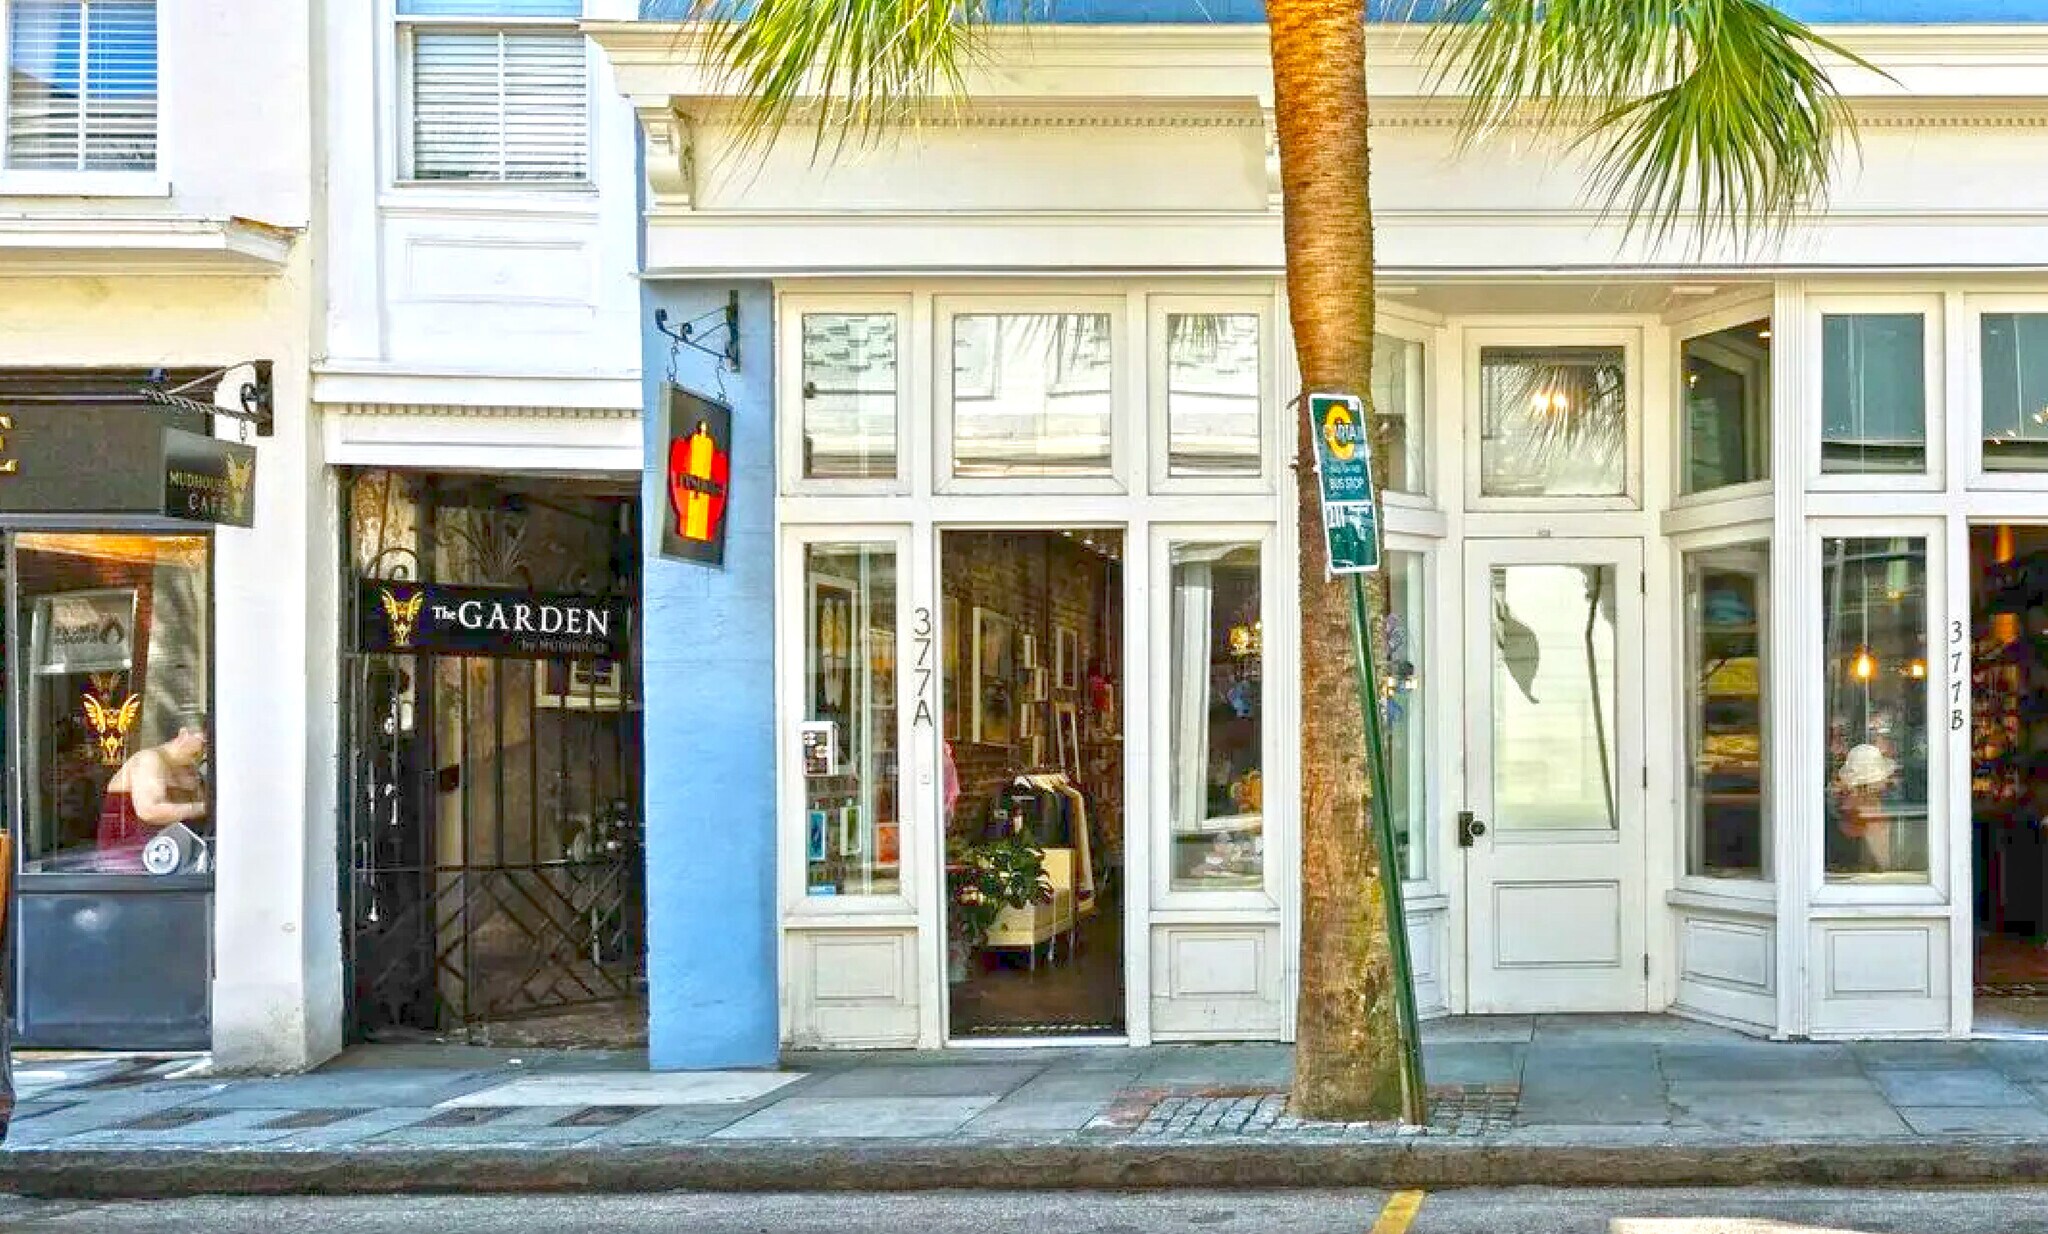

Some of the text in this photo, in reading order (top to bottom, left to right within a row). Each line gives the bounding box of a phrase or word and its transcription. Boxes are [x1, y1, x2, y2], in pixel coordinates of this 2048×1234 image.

[458, 600, 610, 636] GARDEN
[913, 607, 933, 727] 377A
[1951, 620, 1964, 731] 377B
